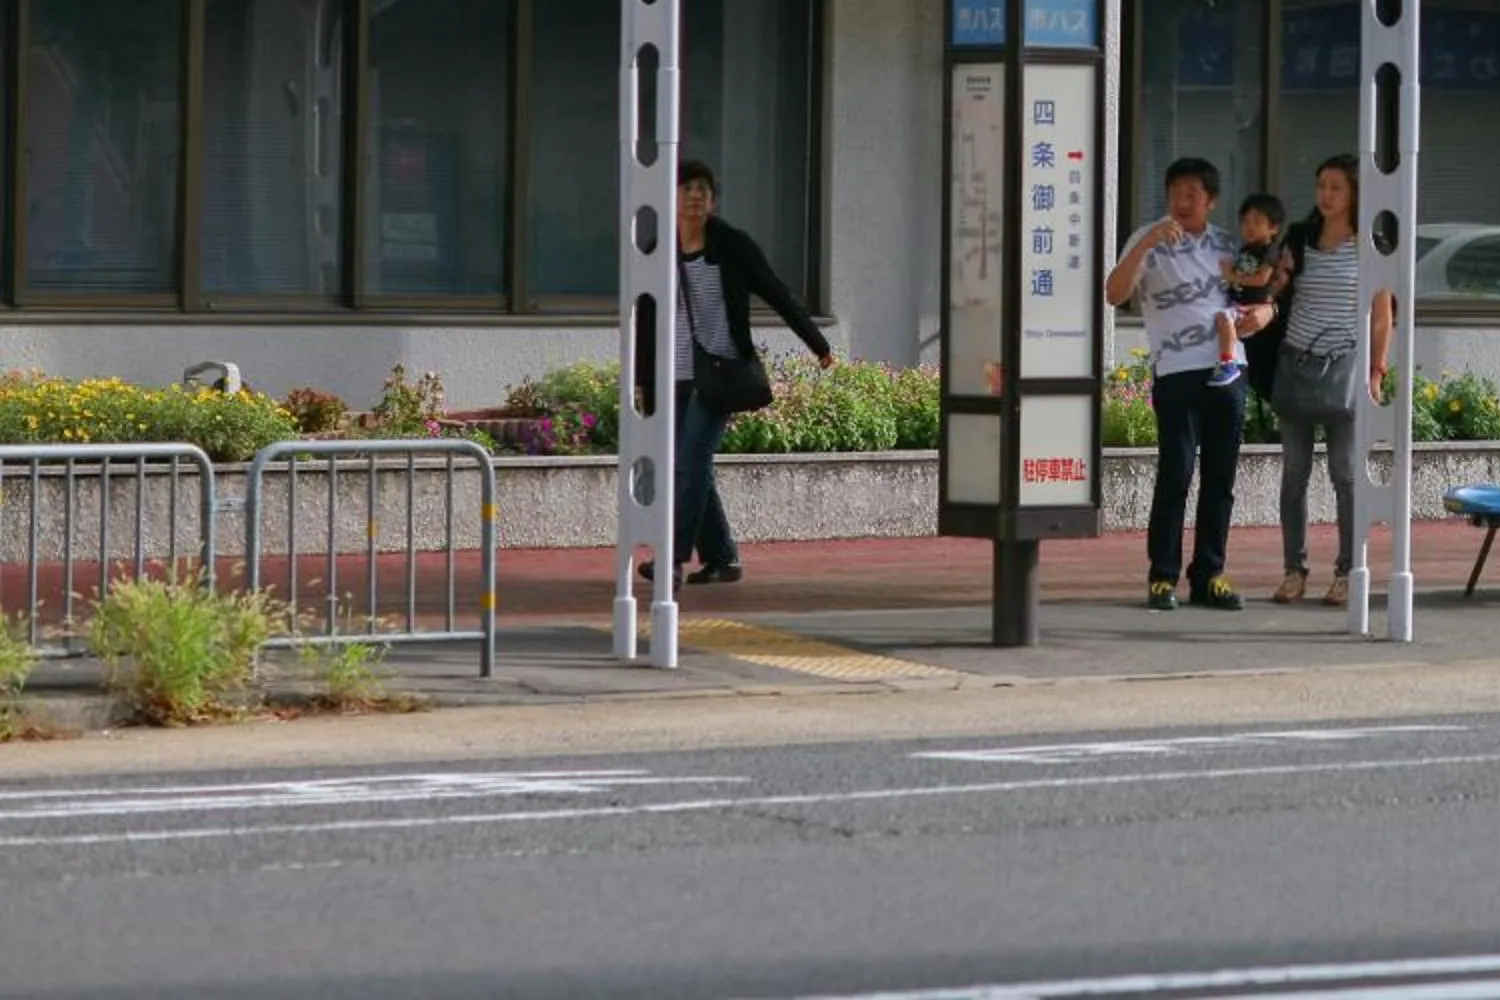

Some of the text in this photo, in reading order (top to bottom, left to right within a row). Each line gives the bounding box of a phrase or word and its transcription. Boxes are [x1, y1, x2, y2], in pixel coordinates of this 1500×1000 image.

[1031, 100, 1055, 297] 四条御前通
[1023, 457, 1087, 484] 駐停車禁止
